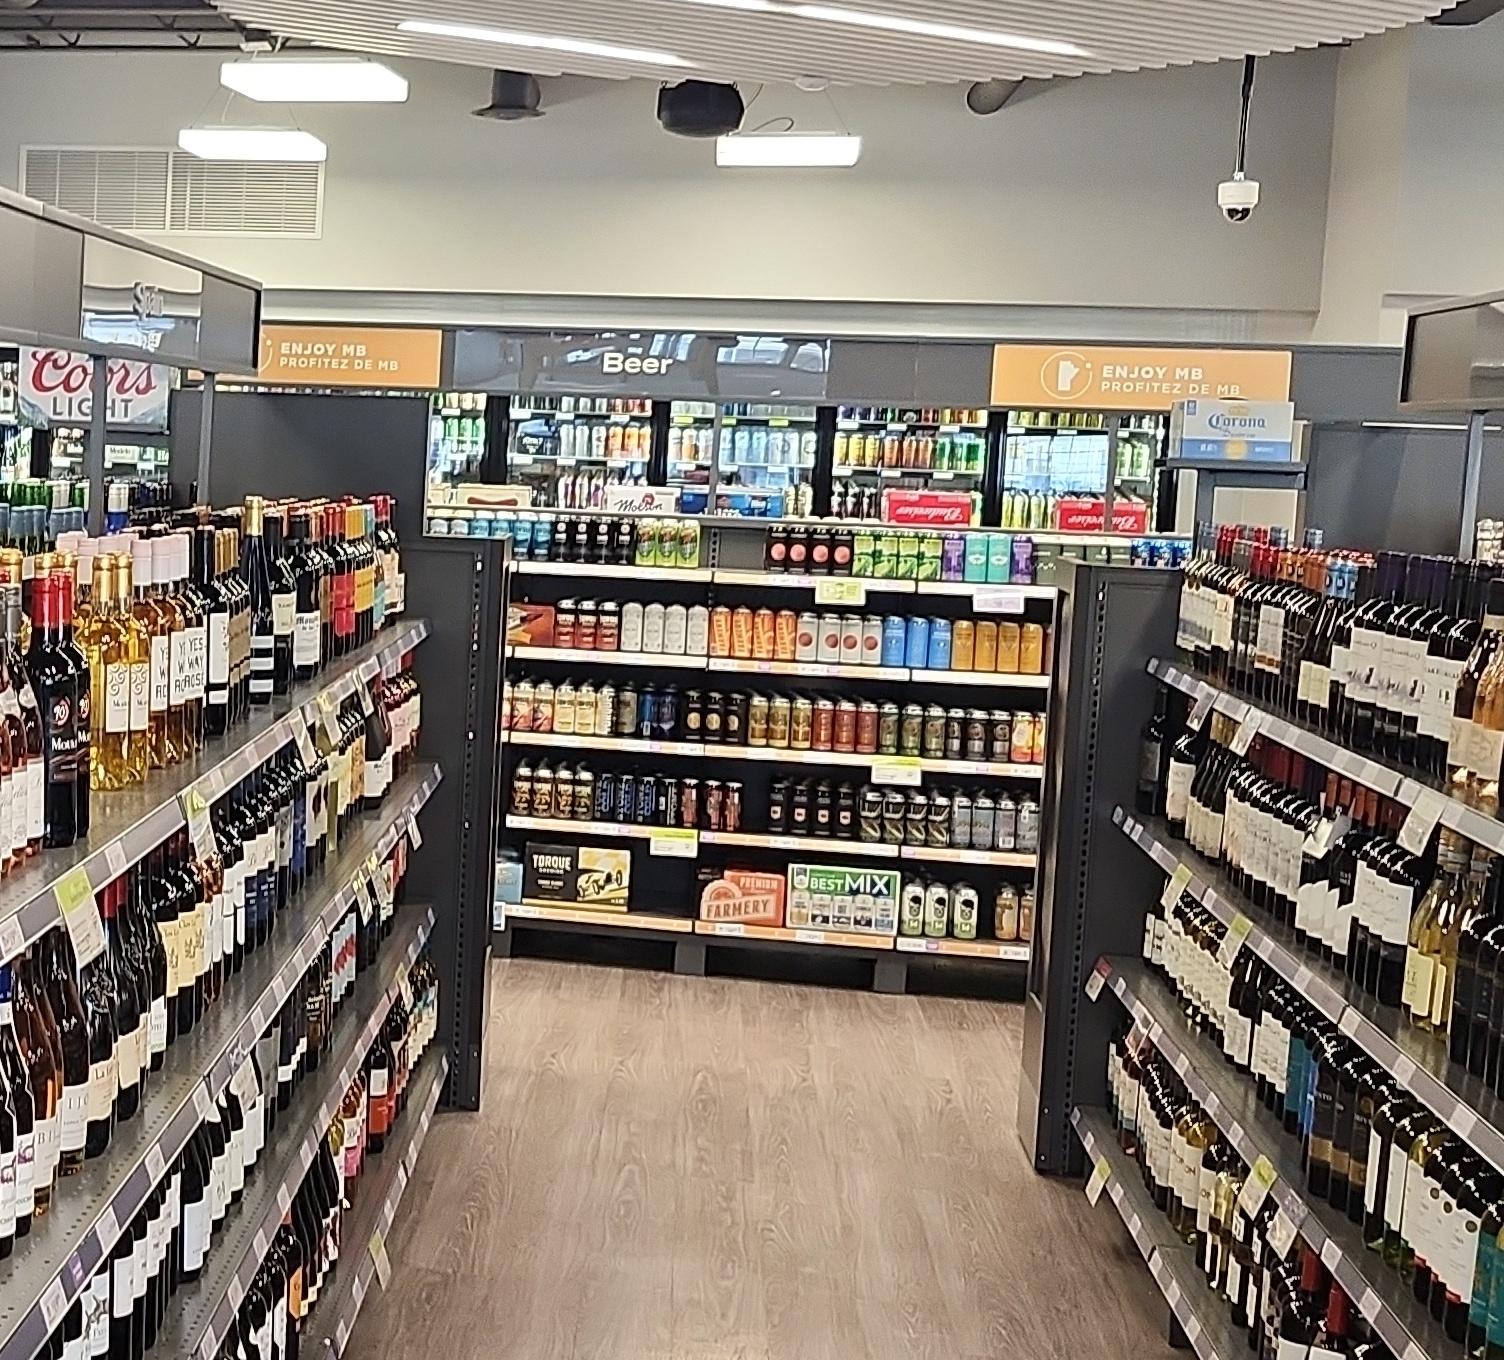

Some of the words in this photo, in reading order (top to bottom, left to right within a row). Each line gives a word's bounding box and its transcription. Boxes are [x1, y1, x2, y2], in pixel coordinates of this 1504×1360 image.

[280, 342, 338, 356] ENJOY
[343, 342, 367, 357] MB
[279, 357, 351, 370] PROFITEZ
[354, 359, 374, 371] DE
[378, 359, 399, 371] MB
[602, 352, 674, 375] Beer
[1102, 366, 1168, 380] ENJOY
[1175, 367, 1204, 380] MB
[1100, 381, 1182, 395] PROFITEZ
[1188, 383, 1211, 395] DE
[1216, 384, 1241, 396] MB
[1208, 413, 1266, 430] Corona
[532, 854, 572, 872] TORQUE
[810, 877, 845, 891] BEST
[844, 873, 890, 895] MIX
[706, 898, 771, 919] FARMERY
